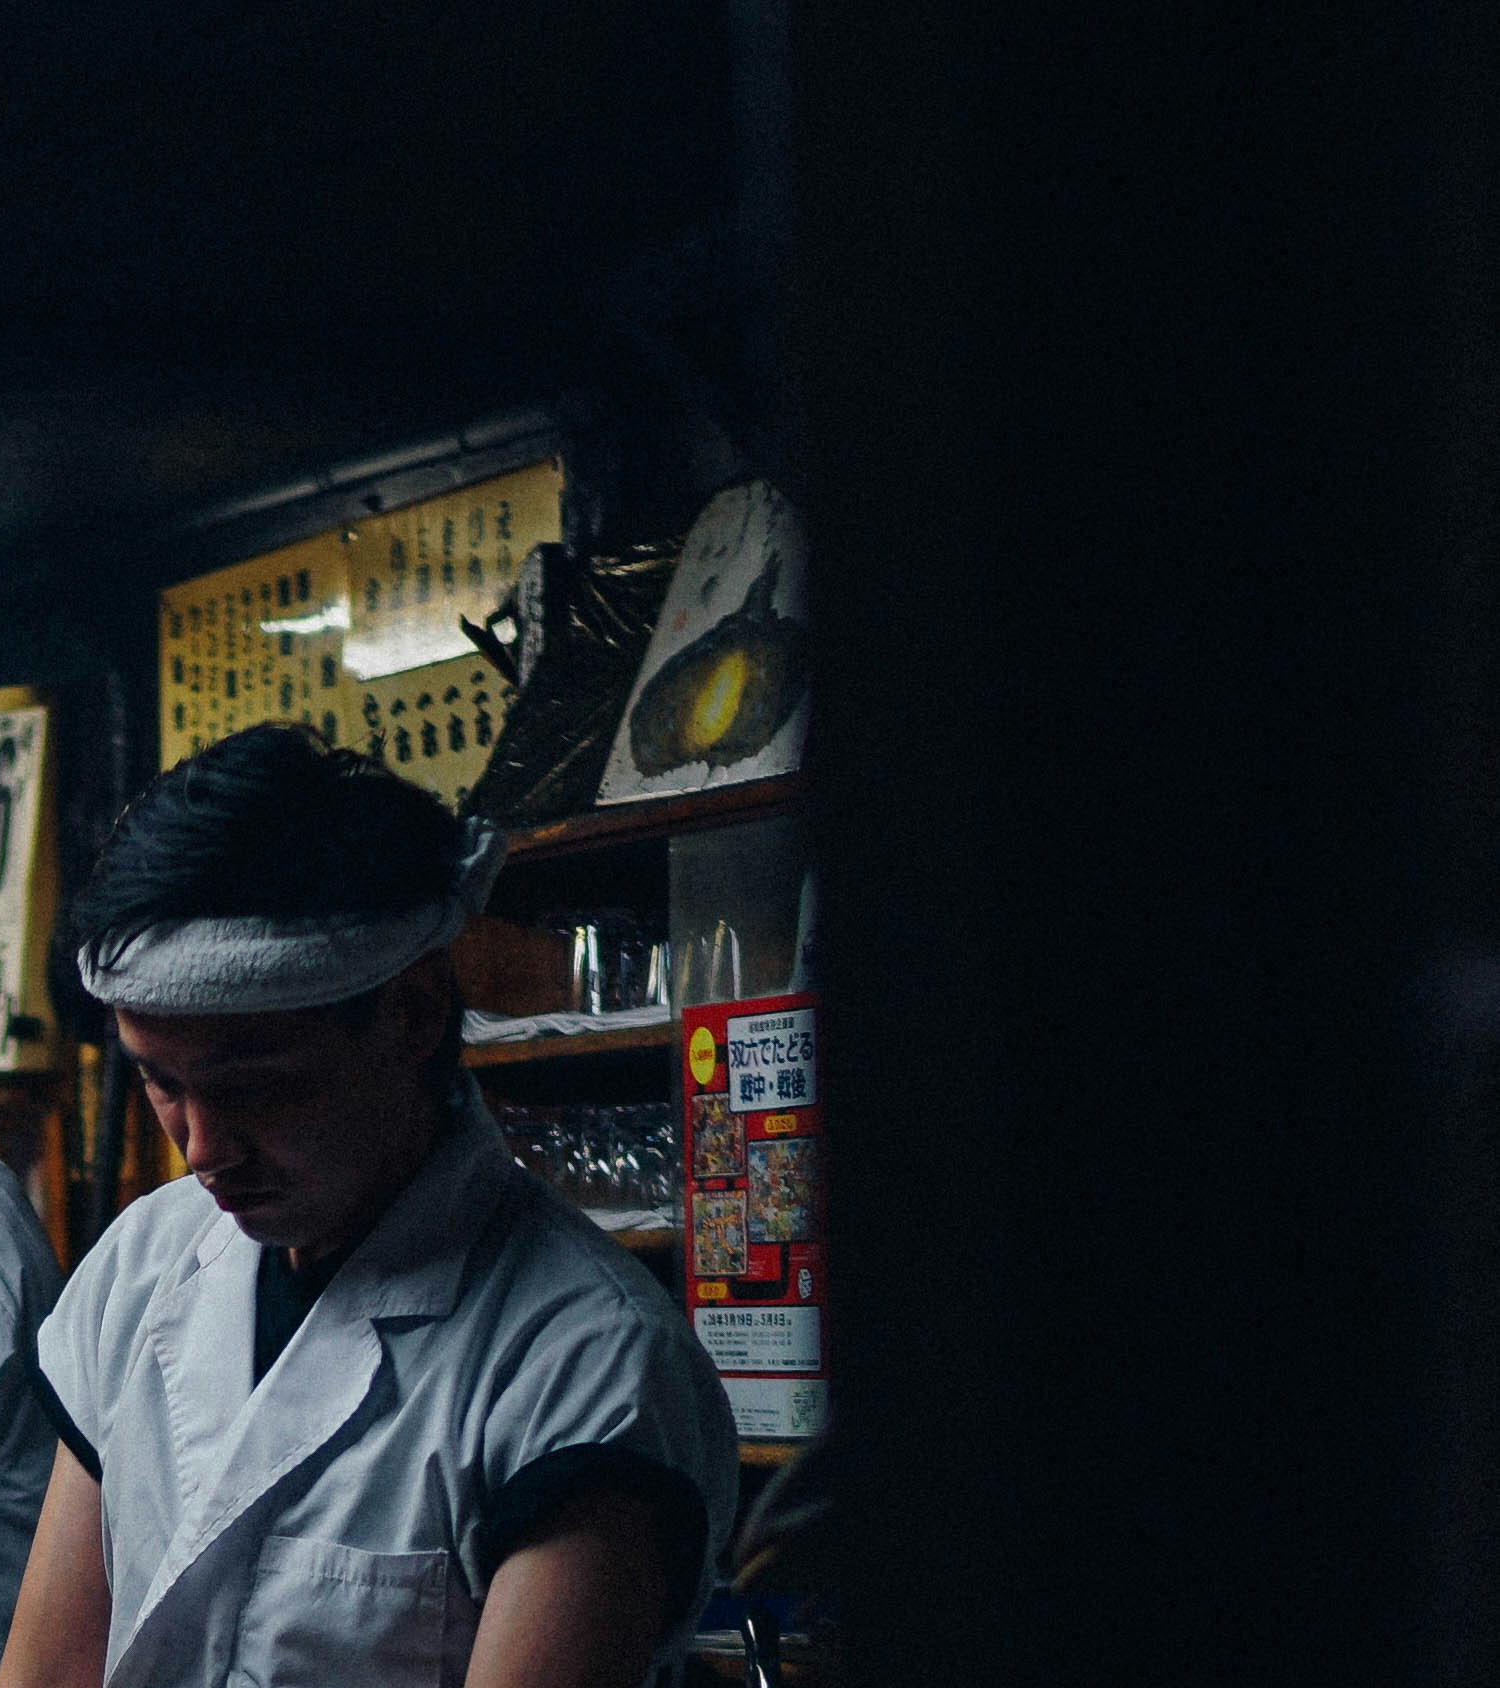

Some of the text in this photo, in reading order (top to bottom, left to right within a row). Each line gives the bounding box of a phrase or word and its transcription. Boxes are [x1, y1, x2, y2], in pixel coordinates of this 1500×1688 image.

[729, 1032, 813, 1068] 双六でたどる
[739, 1068, 807, 1104] 戦中・戦後
